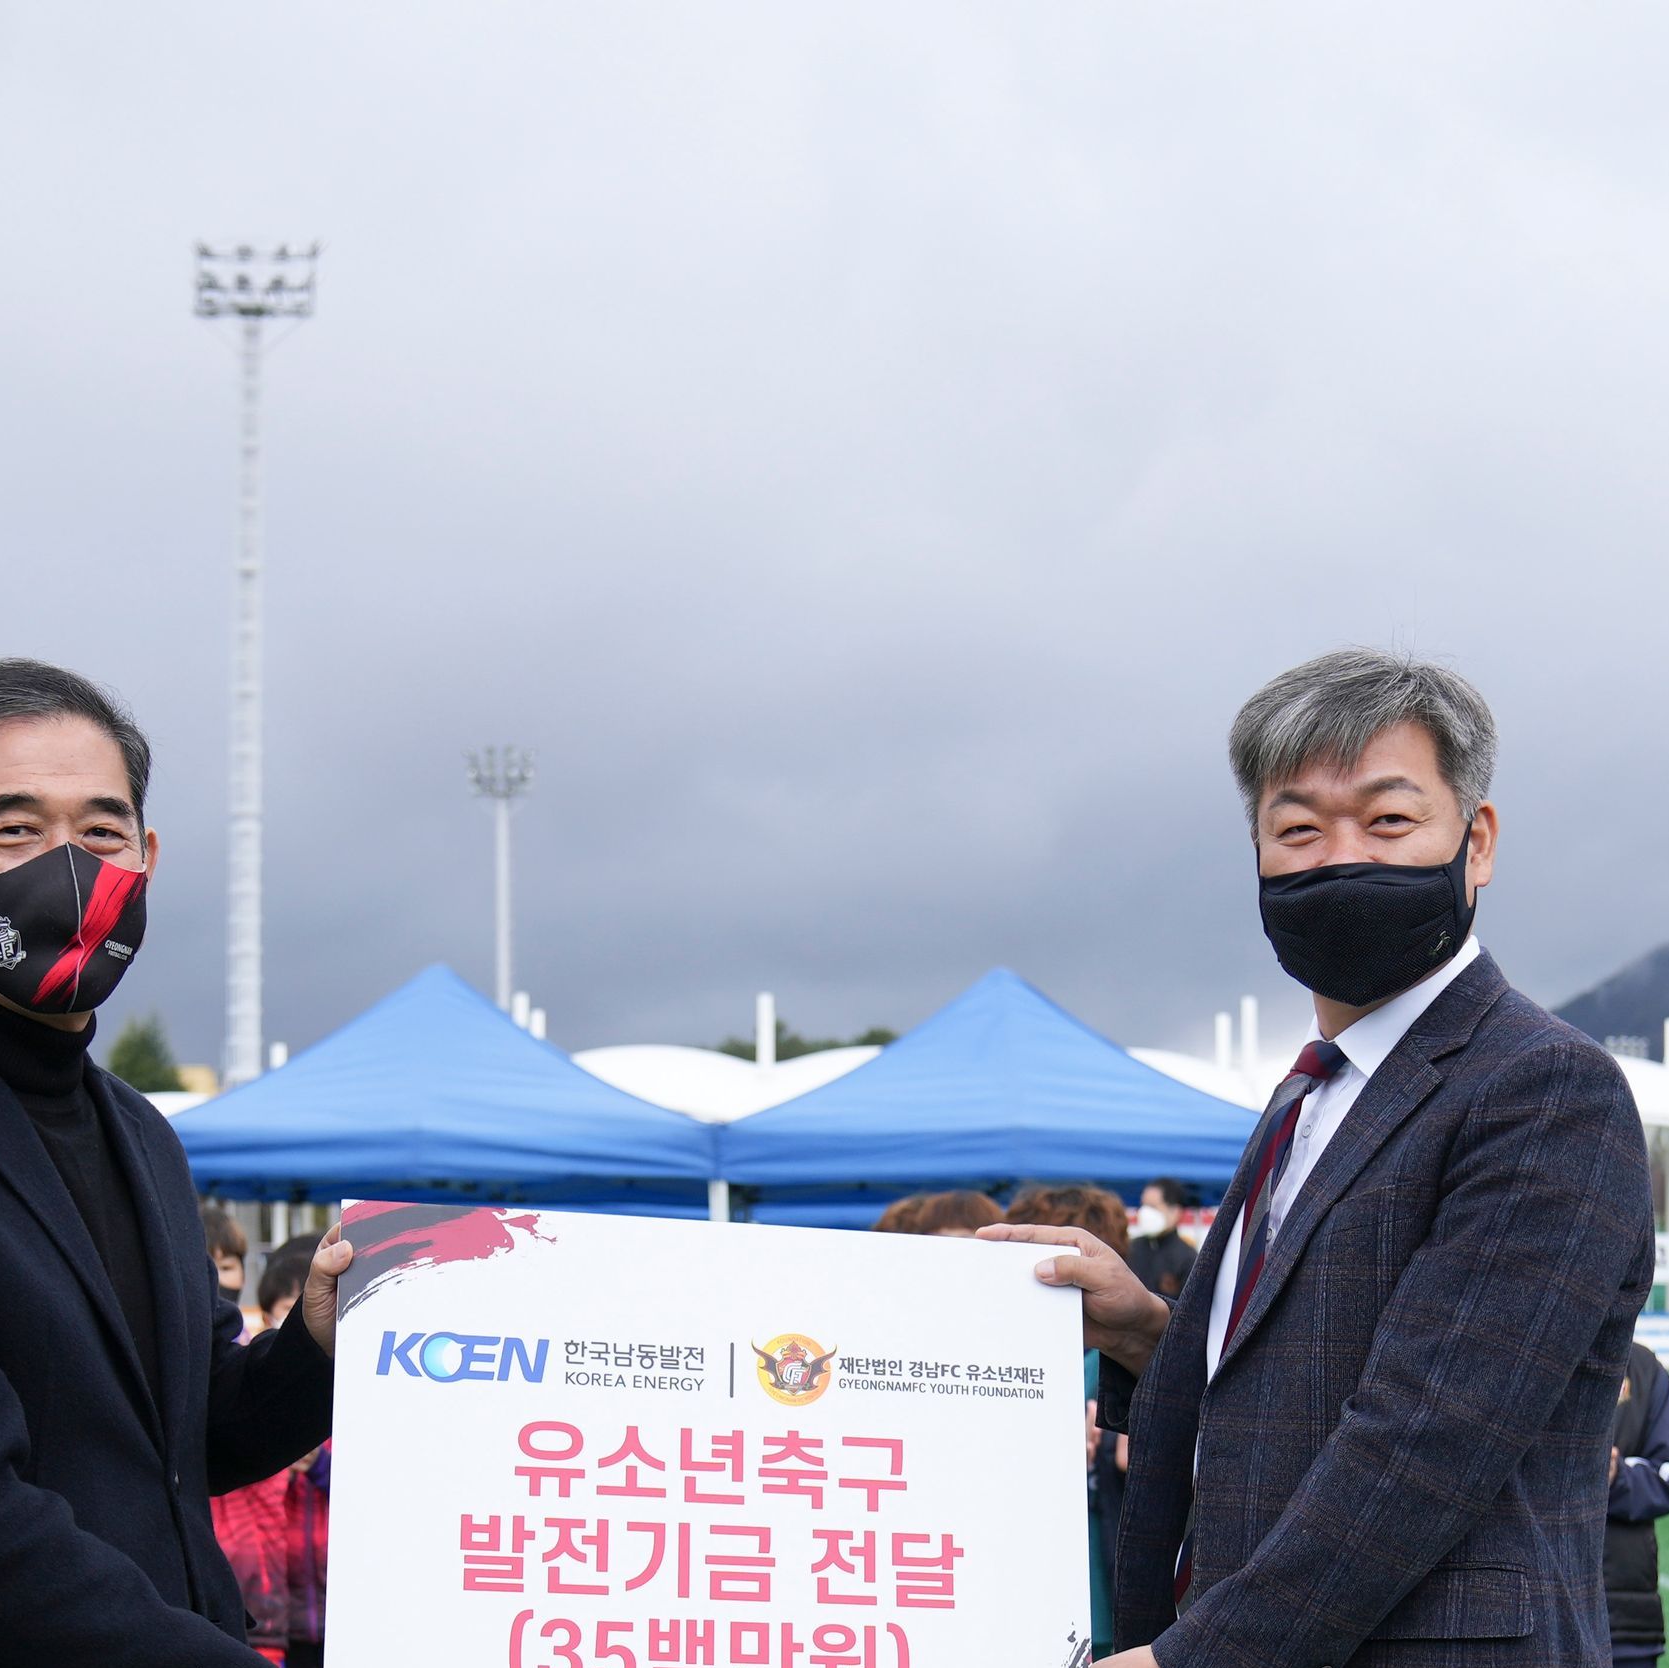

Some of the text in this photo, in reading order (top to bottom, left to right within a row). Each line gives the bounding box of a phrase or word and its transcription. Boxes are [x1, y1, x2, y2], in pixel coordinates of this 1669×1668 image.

[564, 1340, 705, 1371] 한국남동발전
[565, 1371, 705, 1391] KOREA ENERGY
[839, 1357, 1045, 1385] 재단법인 경남FC 유소년재단
[839, 1378, 1044, 1399] GYEONGNAMFC YOUTH FOUNDATION
[514, 1420, 908, 1512] 유소년축구
[459, 1513, 964, 1610] 발전기금 전달
